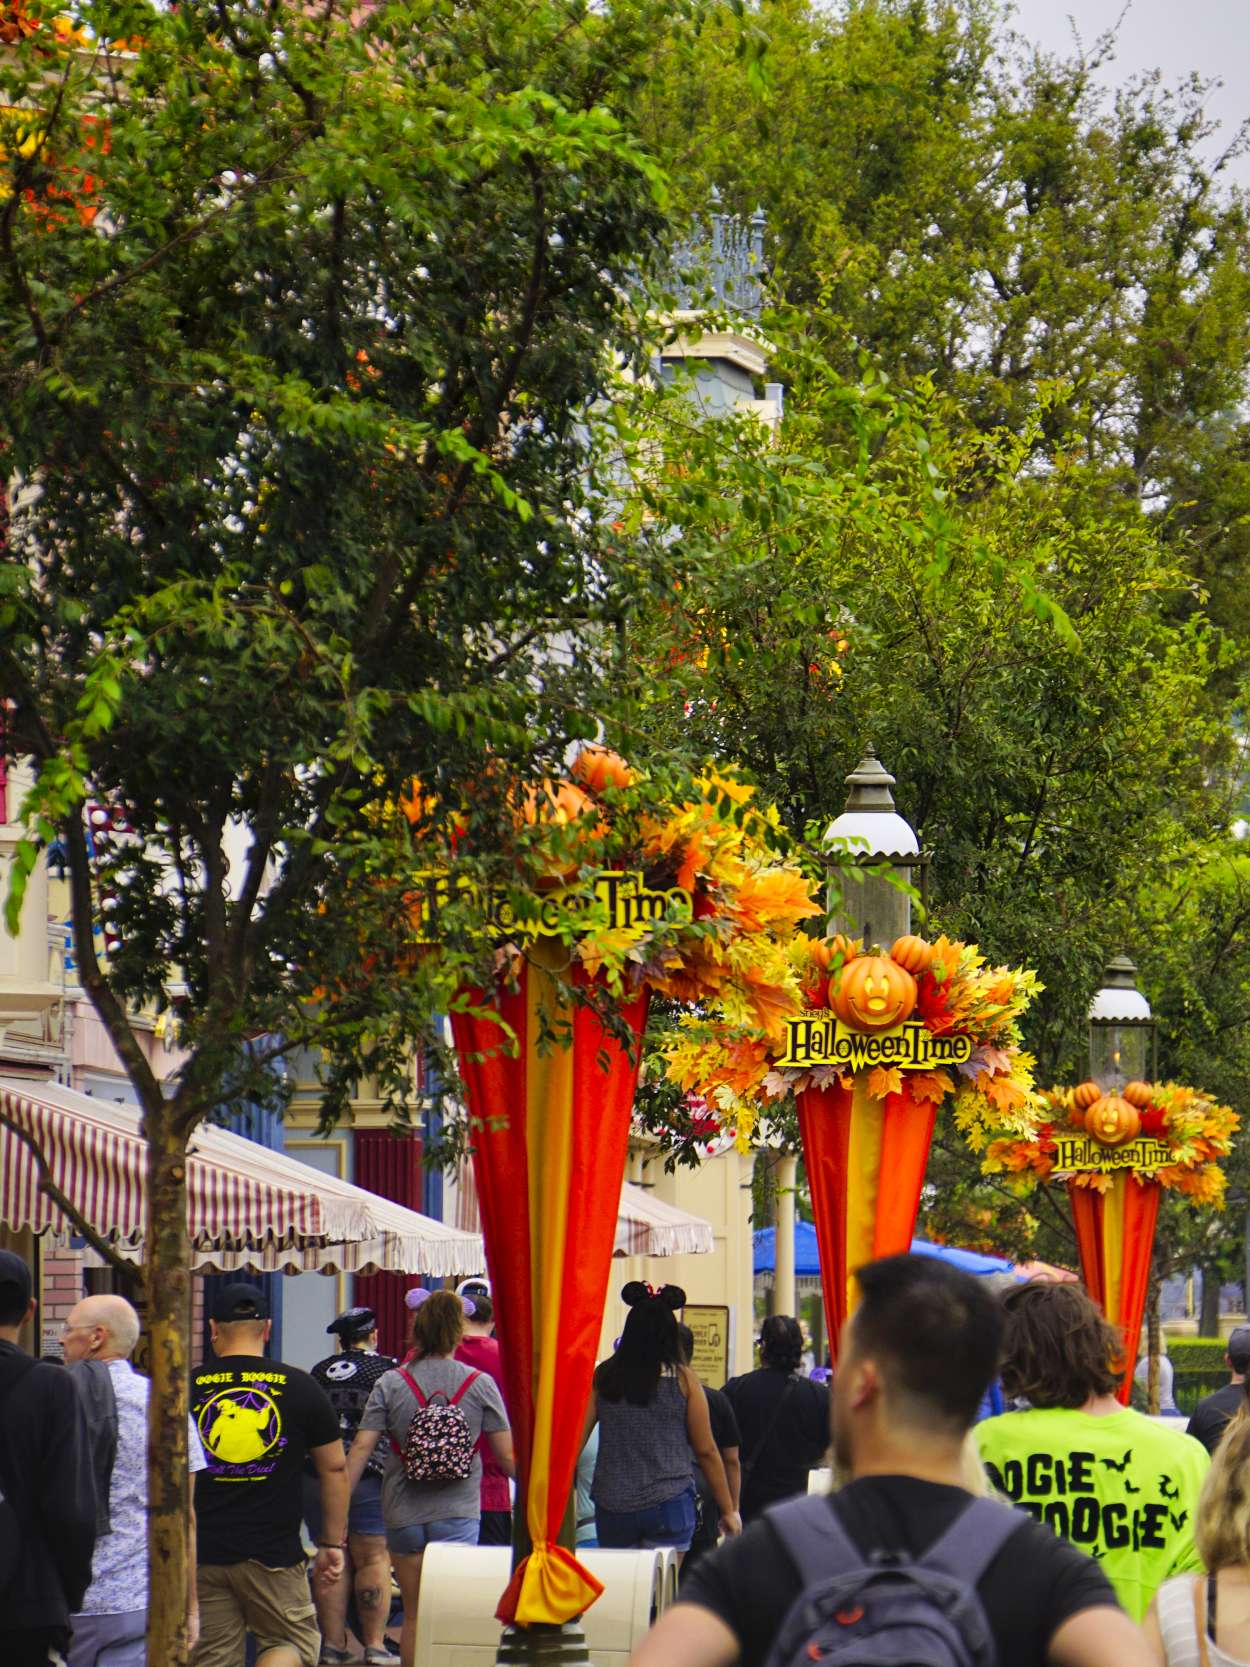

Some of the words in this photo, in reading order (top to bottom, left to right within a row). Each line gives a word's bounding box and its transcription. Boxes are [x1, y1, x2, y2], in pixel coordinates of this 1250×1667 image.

[800, 1008, 830, 1020] sney's
[787, 1019, 968, 1064] HalloweenTime
[196, 1373, 234, 1385] OOGIE
[241, 1372, 287, 1385] BOOGIE
